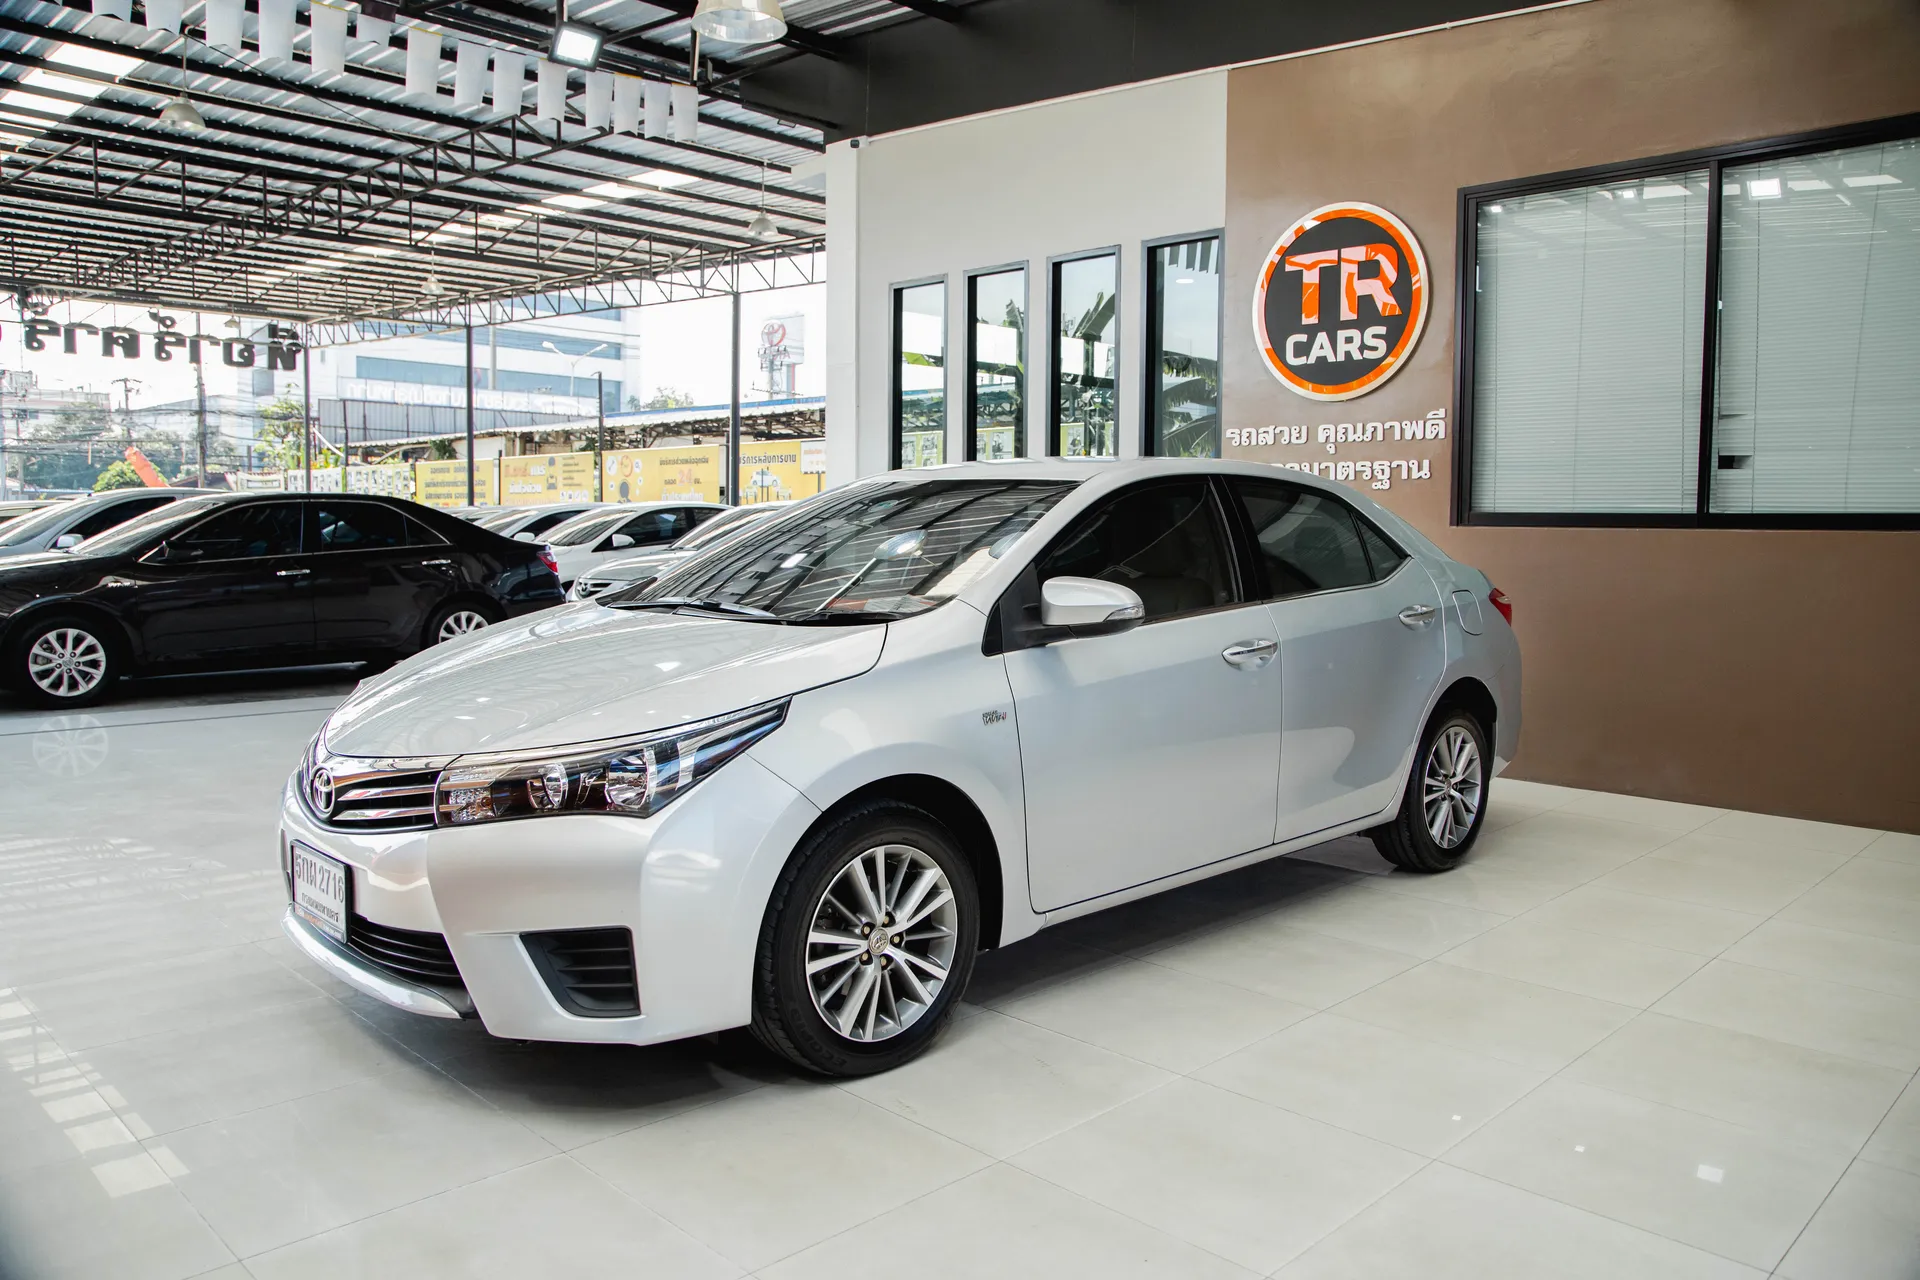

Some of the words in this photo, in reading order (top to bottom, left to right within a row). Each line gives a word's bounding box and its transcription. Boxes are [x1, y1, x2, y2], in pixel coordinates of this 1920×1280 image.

[1285, 242, 1403, 325] TR
[1285, 325, 1388, 366] CARS
[1225, 424, 1308, 447] รถสวย
[1317, 408, 1447, 455] คุณภาพดี
[677, 468, 693, 486] 24
[740, 452, 797, 466] ริการหลังการขาย
[1271, 459, 1431, 490] มาตรฐาน
[319, 864, 345, 904] 2716
